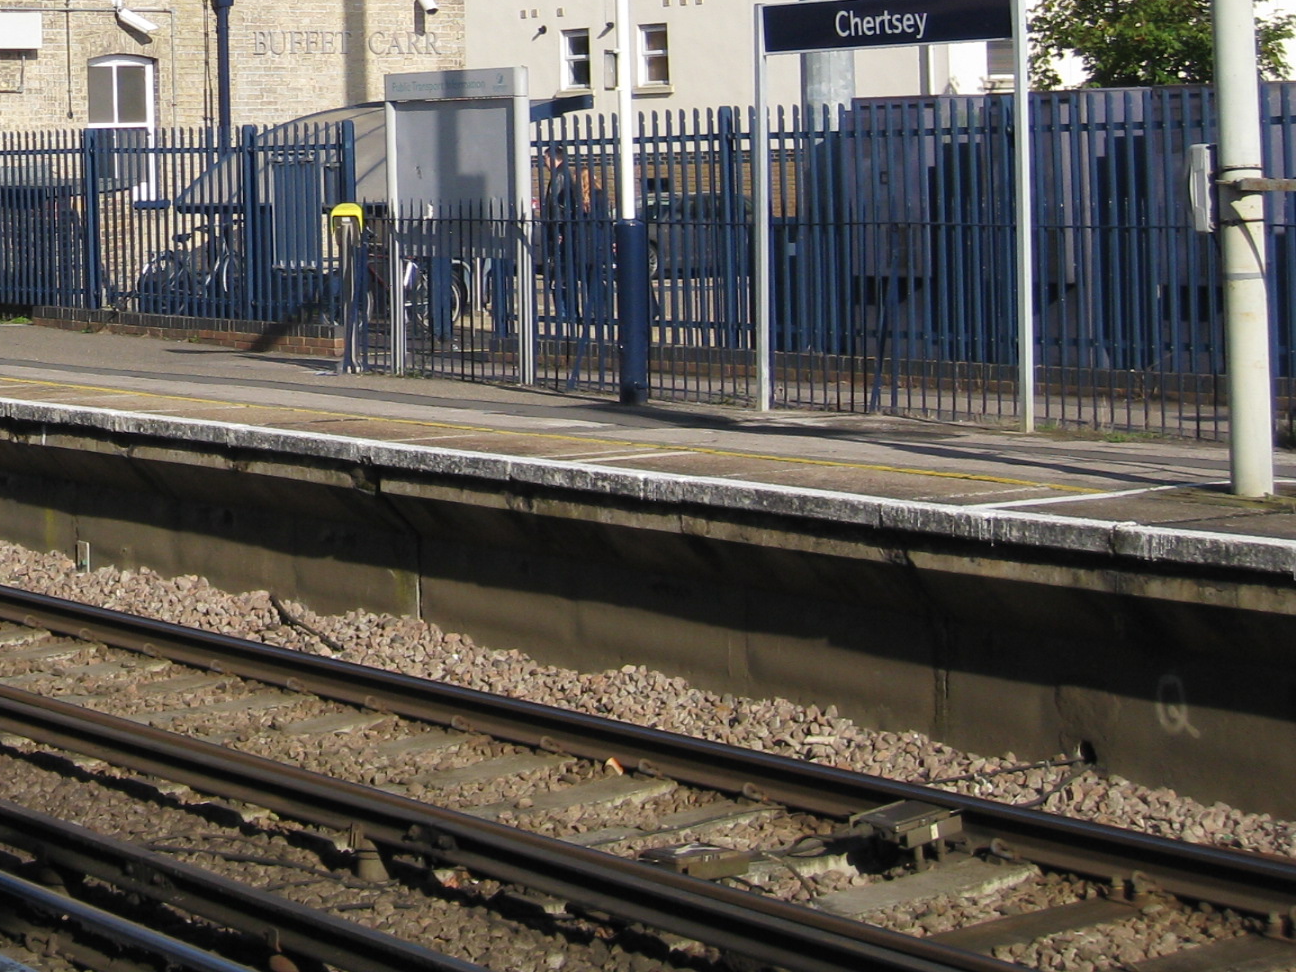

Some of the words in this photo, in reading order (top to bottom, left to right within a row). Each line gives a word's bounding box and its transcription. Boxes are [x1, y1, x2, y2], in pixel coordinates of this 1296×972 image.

[835, 10, 927, 39] Chertsey
[252, 31, 352, 55] BUFFET
[368, 31, 442, 55] CARR
[391, 81, 411, 92] Public
[412, 80, 445, 93] Transport
[446, 79, 486, 90] Information
[1155, 674, 1201, 739] Q
